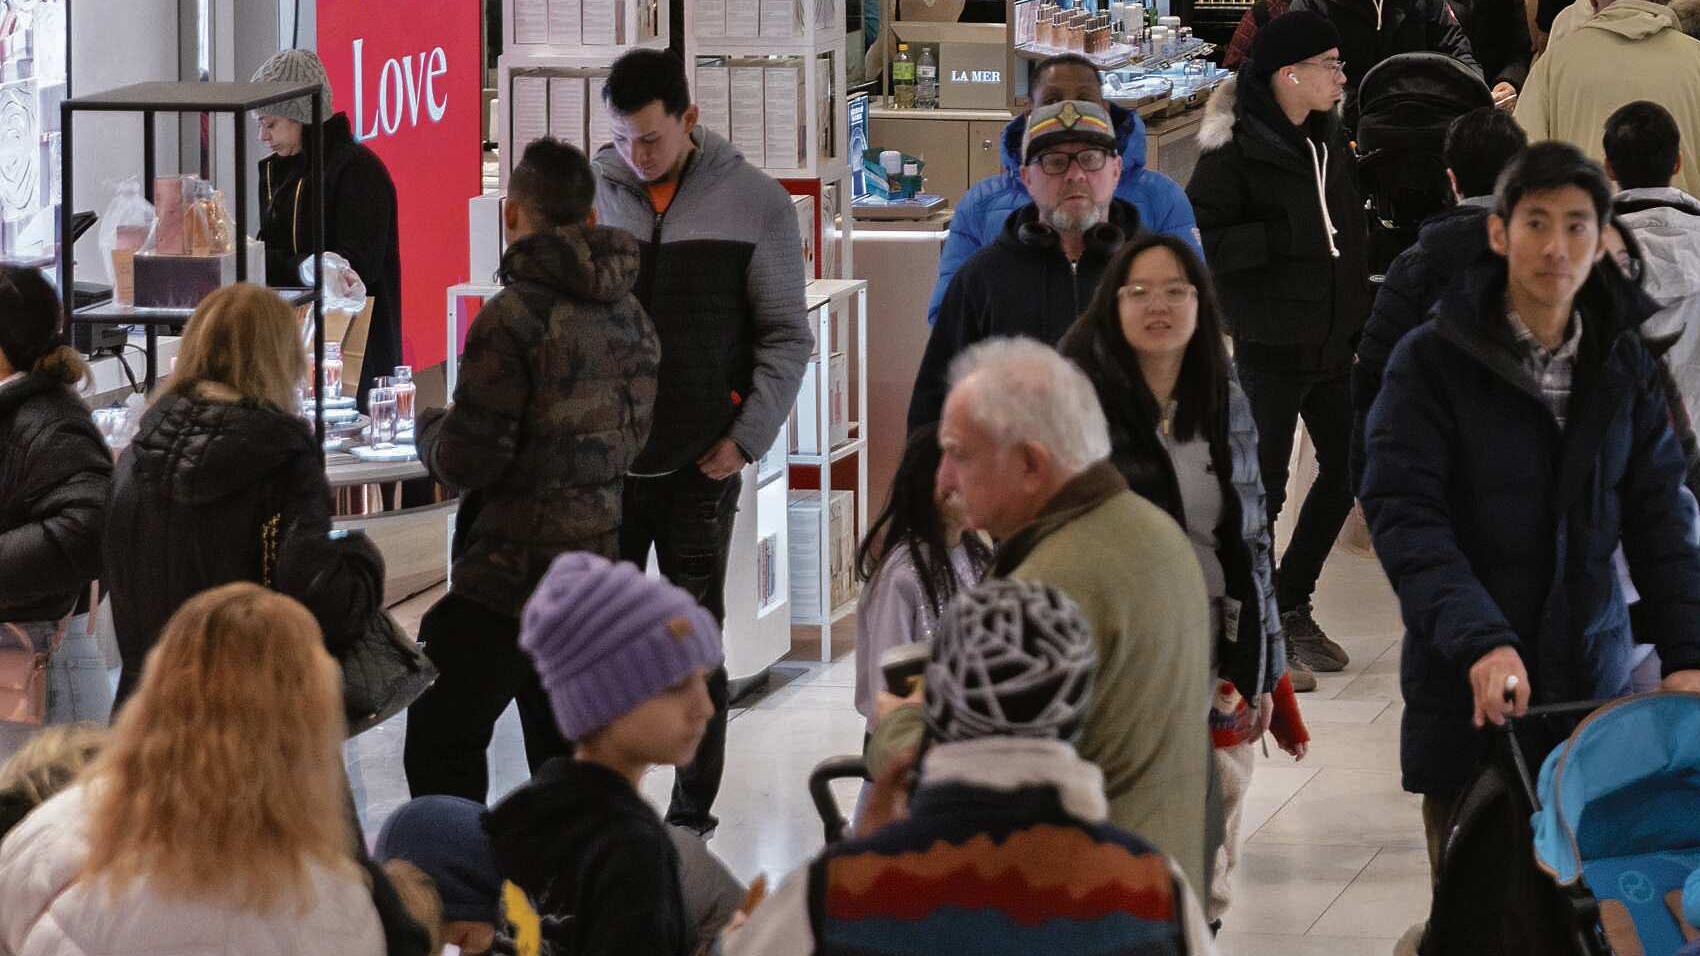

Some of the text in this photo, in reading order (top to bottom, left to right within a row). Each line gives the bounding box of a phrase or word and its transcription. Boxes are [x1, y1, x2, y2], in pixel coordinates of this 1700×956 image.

[353, 38, 448, 143] Love
[952, 70, 1000, 82] LA MER
